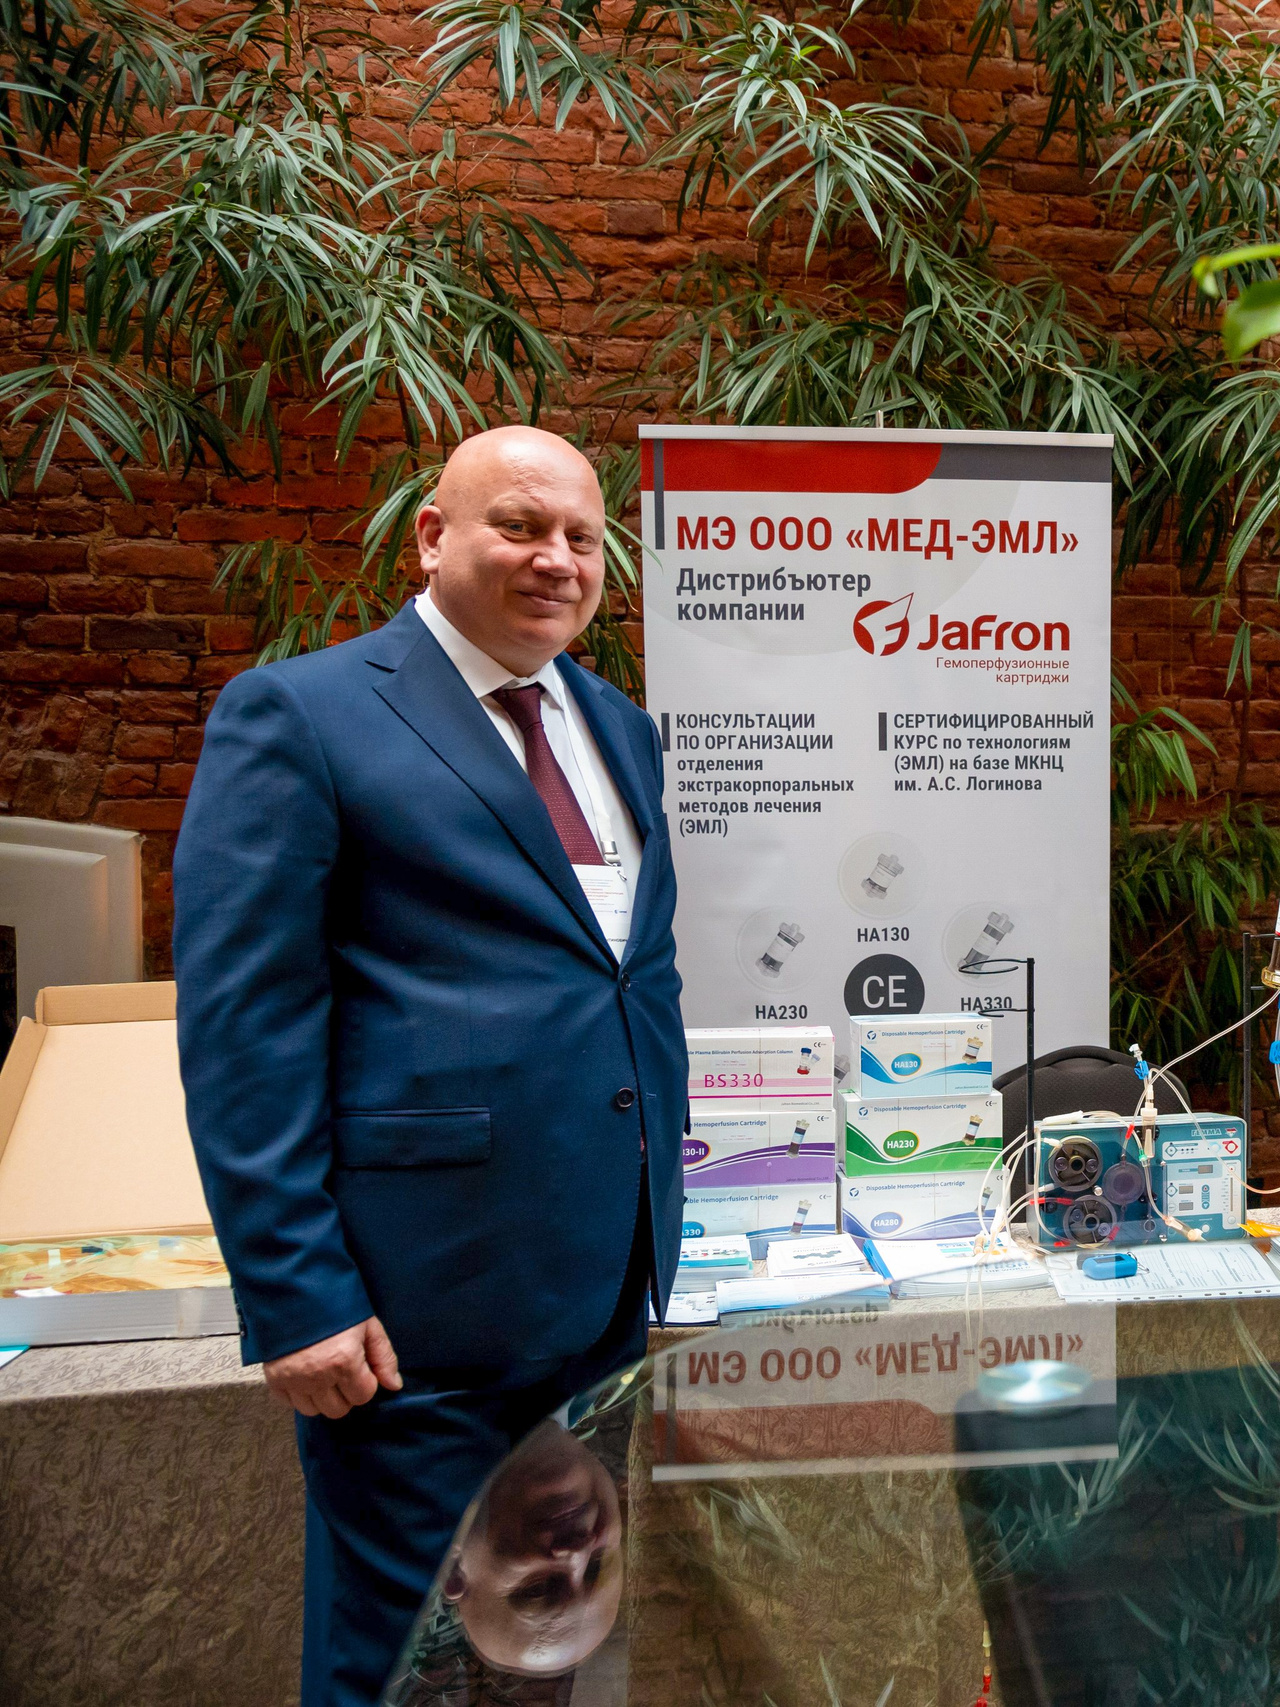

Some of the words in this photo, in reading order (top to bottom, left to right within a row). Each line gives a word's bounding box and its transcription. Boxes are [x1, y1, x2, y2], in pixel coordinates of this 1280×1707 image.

[677, 516, 736, 550] МЭ
[750, 517, 832, 551] ООО
[847, 518, 1079, 560] «МЕД-ЭМЛ»
[676, 567, 871, 597] Дистрибъютер
[677, 599, 804, 621] компании
[917, 614, 1070, 651] Jafron
[936, 656, 1070, 671] Гемоперфузионные
[996, 672, 1069, 685] картриджи
[676, 713, 815, 731] КОНСУЛЬТАЦИИ
[894, 710, 1094, 731] СЕРТИФИЦИРОВАННЫЙ
[677, 735, 700, 750] ПО
[704, 734, 833, 752] ОРГАНИЗАЦИИ
[894, 734, 938, 750] КУРС
[943, 737, 962, 750] по
[967, 737, 1071, 750] технологиям
[677, 758, 763, 772] отделения
[894, 755, 944, 774] (ЭМЛ)
[950, 758, 968, 771] на
[973, 755, 1010, 771] базе
[1015, 755, 1064, 773] МКНЦ
[678, 778, 854, 795] экстракорпоральных
[894, 778, 921, 792] им.
[928, 776, 960, 792] А.С.
[966, 776, 1042, 792] Логинова
[679, 798, 749, 814] методов
[754, 800, 822, 814] лечения
[679, 819, 728, 838] (ЭМЛ)
[857, 926, 910, 943] HA130
[863, 975, 907, 1008] CE
[755, 1004, 808, 1021] HA230
[961, 997, 1012, 1013] HA330
[704, 1073, 763, 1088] BS330
[694, 1120, 739, 1128] Hemoperfusion
[740, 1119, 767, 1127] Cartridge
[887, 1140, 914, 1149] HA230
[866, 1183, 896, 1192] Disposable
[897, 1182, 939, 1190] Hemoperfusion
[940, 1180, 965, 1188] Cartridge
[700, 1195, 749, 1204] Hemoperfusion
[750, 1194, 779, 1202] Cartridge
[874, 1219, 899, 1227] HA280
